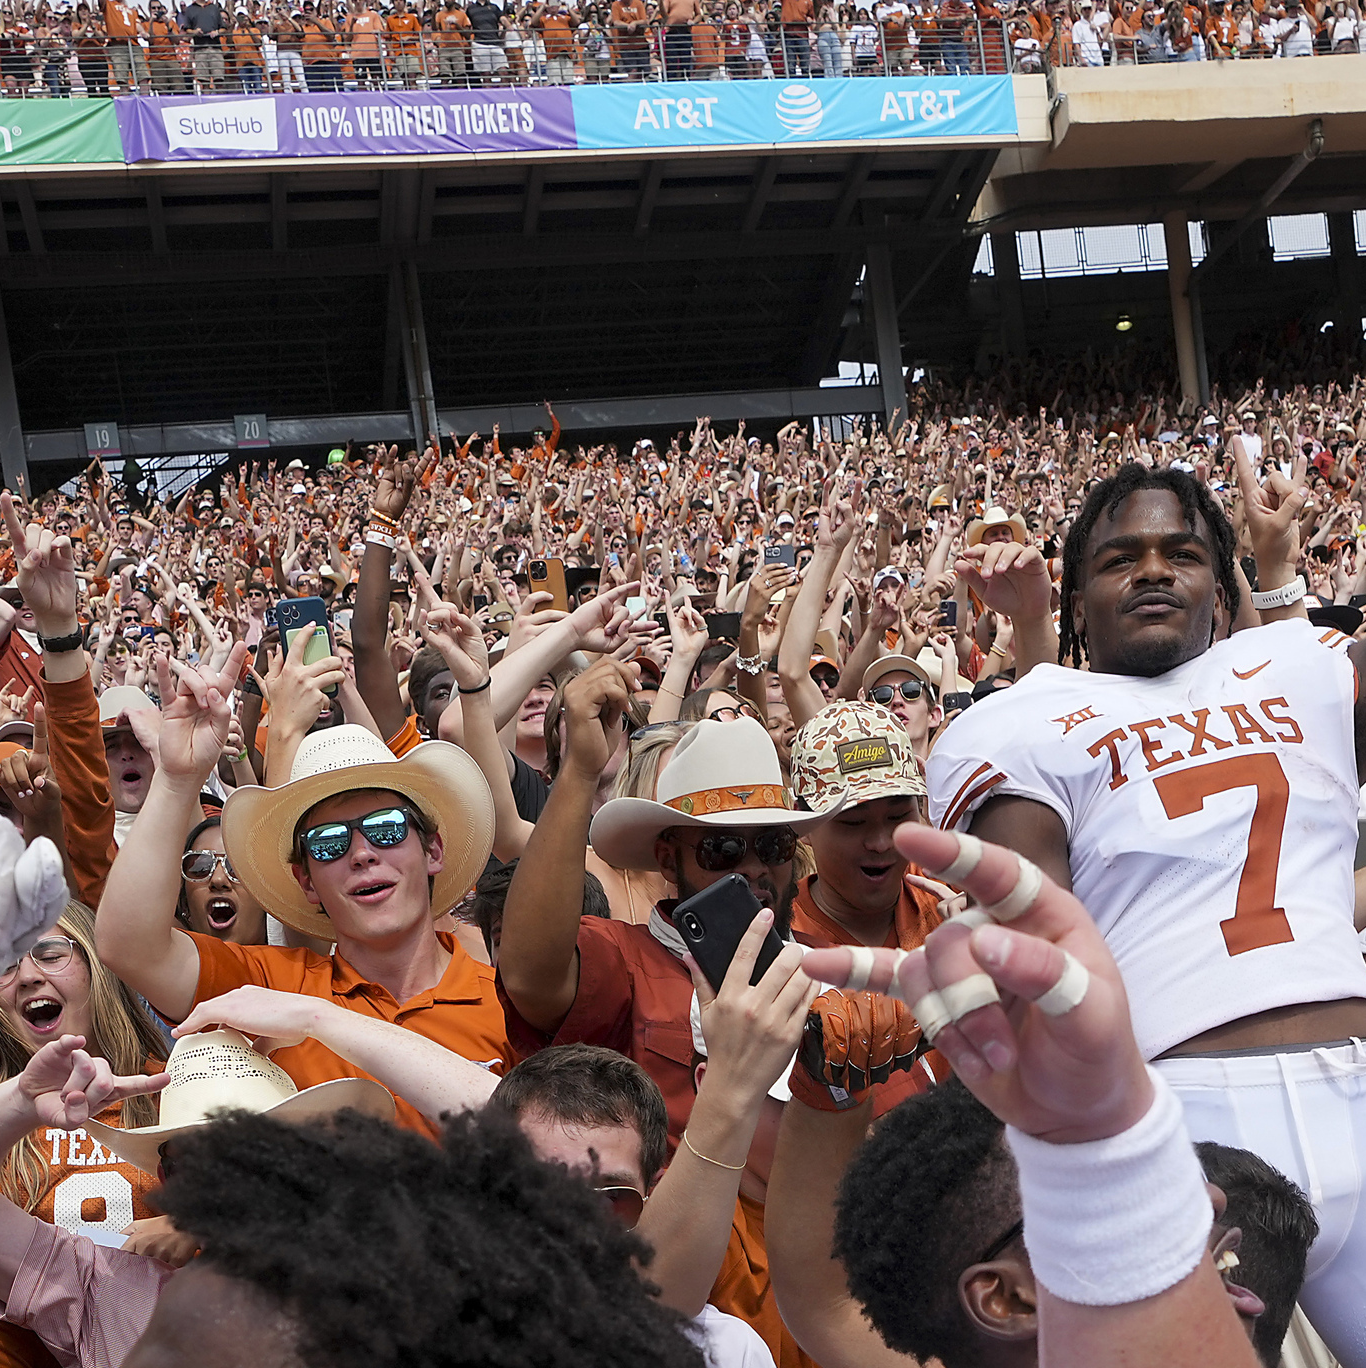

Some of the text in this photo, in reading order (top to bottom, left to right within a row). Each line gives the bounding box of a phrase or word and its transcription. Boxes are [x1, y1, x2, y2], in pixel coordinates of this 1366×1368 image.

[292, 102, 535, 139] 100% VERIFIED TICKETS
[634, 97, 718, 129] AT&T
[879, 89, 961, 121] AT&T
[179, 117, 264, 136] StubHub
[95, 429, 110, 448] 19
[243, 421, 260, 440] 20
[371, 523, 393, 535] TEXAS
[1050, 705, 1105, 736] XII
[843, 744, 886, 763] Amigo
[1086, 696, 1304, 791] TEXAS
[1152, 751, 1295, 957] 7
[45, 1128, 127, 1166] TEX
